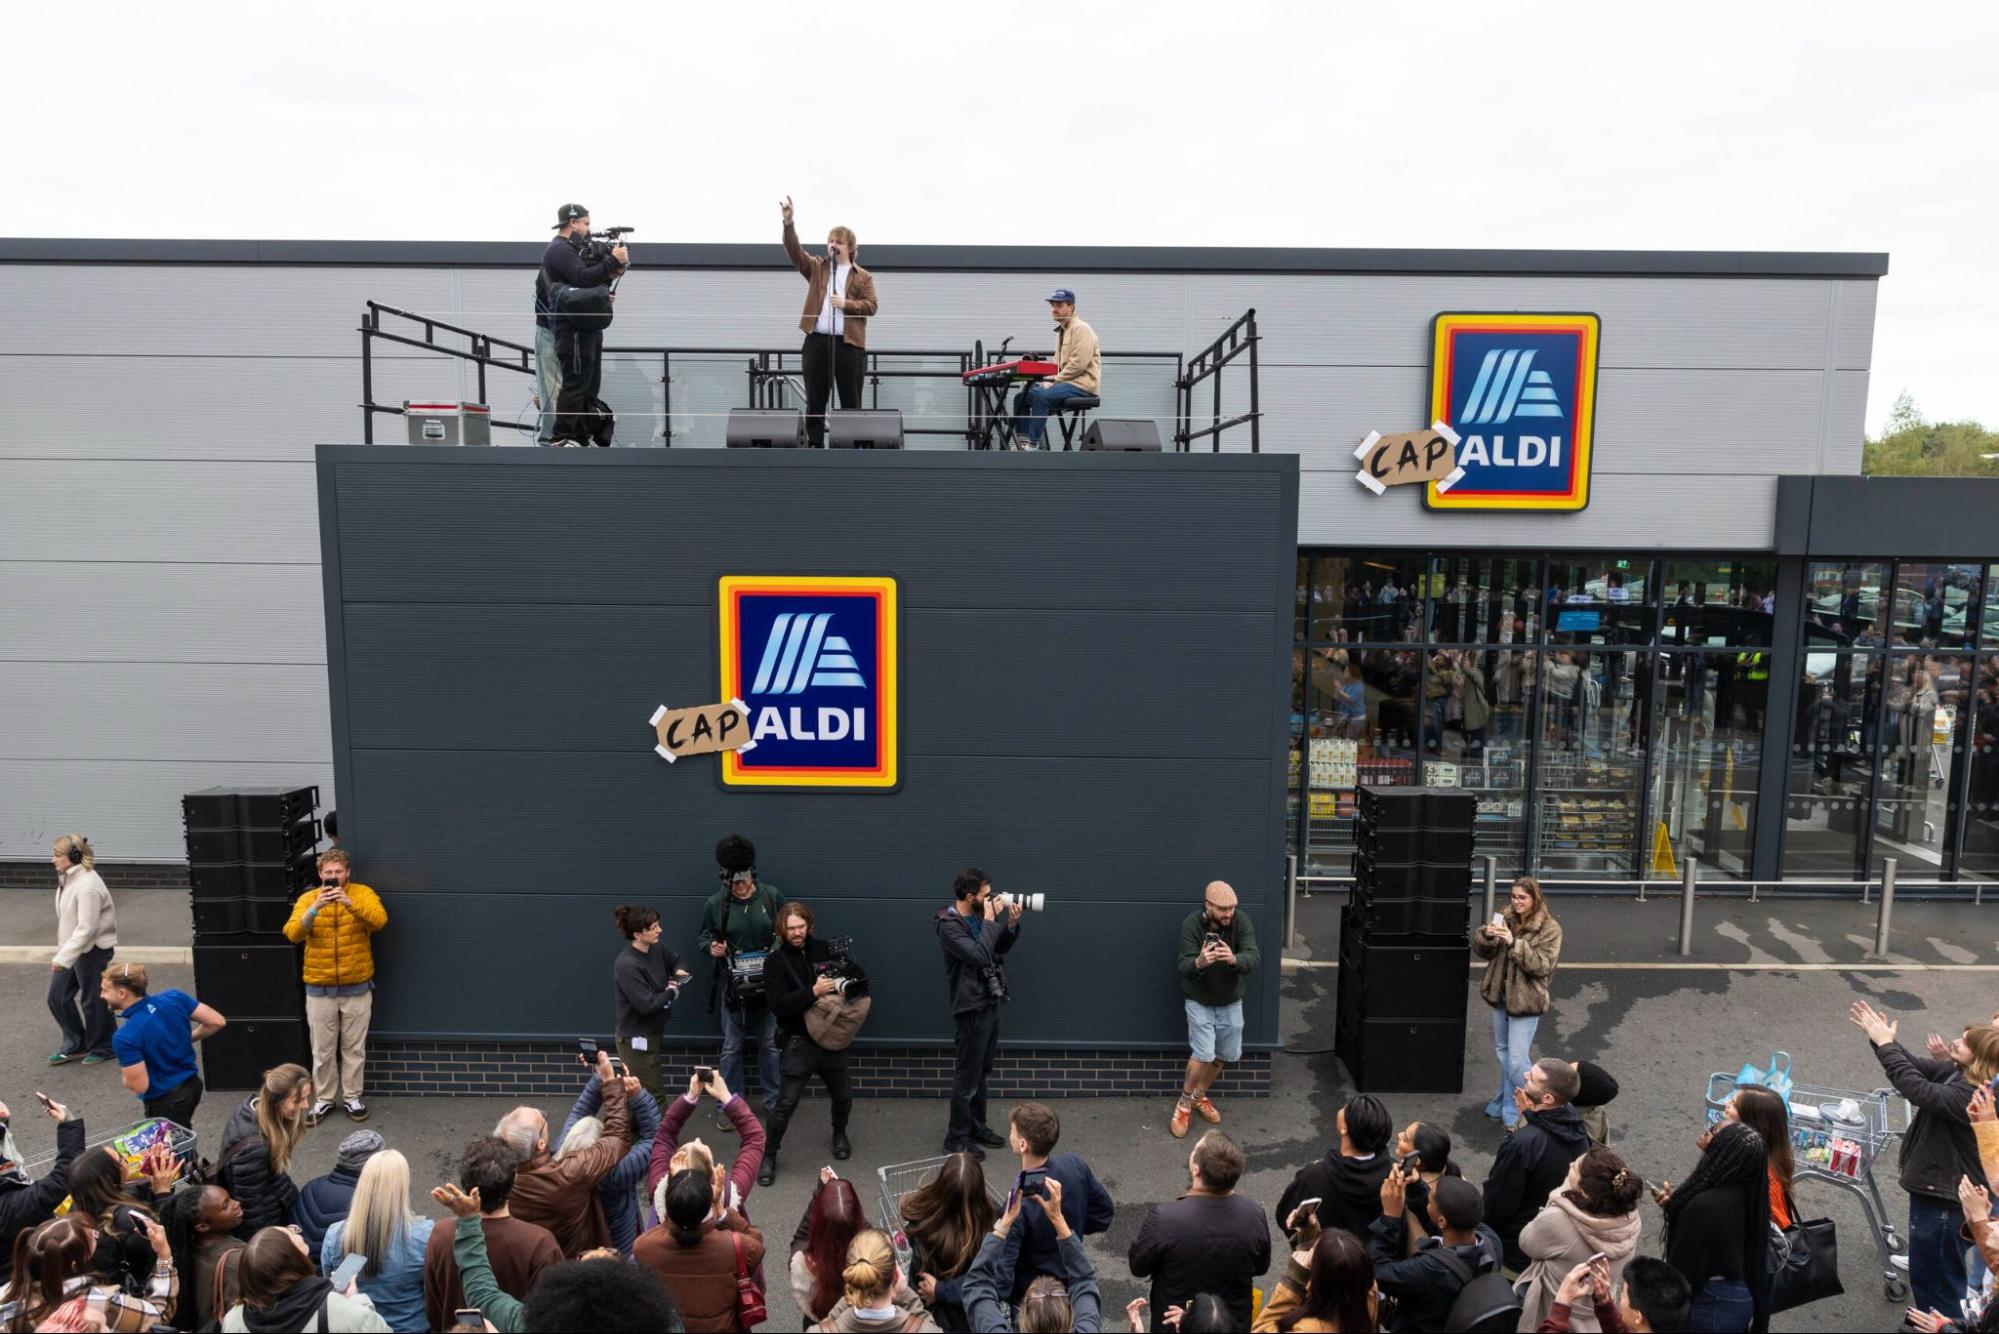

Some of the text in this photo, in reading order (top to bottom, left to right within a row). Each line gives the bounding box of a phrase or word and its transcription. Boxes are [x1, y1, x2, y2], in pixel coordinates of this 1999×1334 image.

[1370, 437, 1448, 478] CAP
[1458, 435, 1561, 467] ALDI
[666, 710, 739, 749] CAP
[752, 706, 866, 741] ALDI
